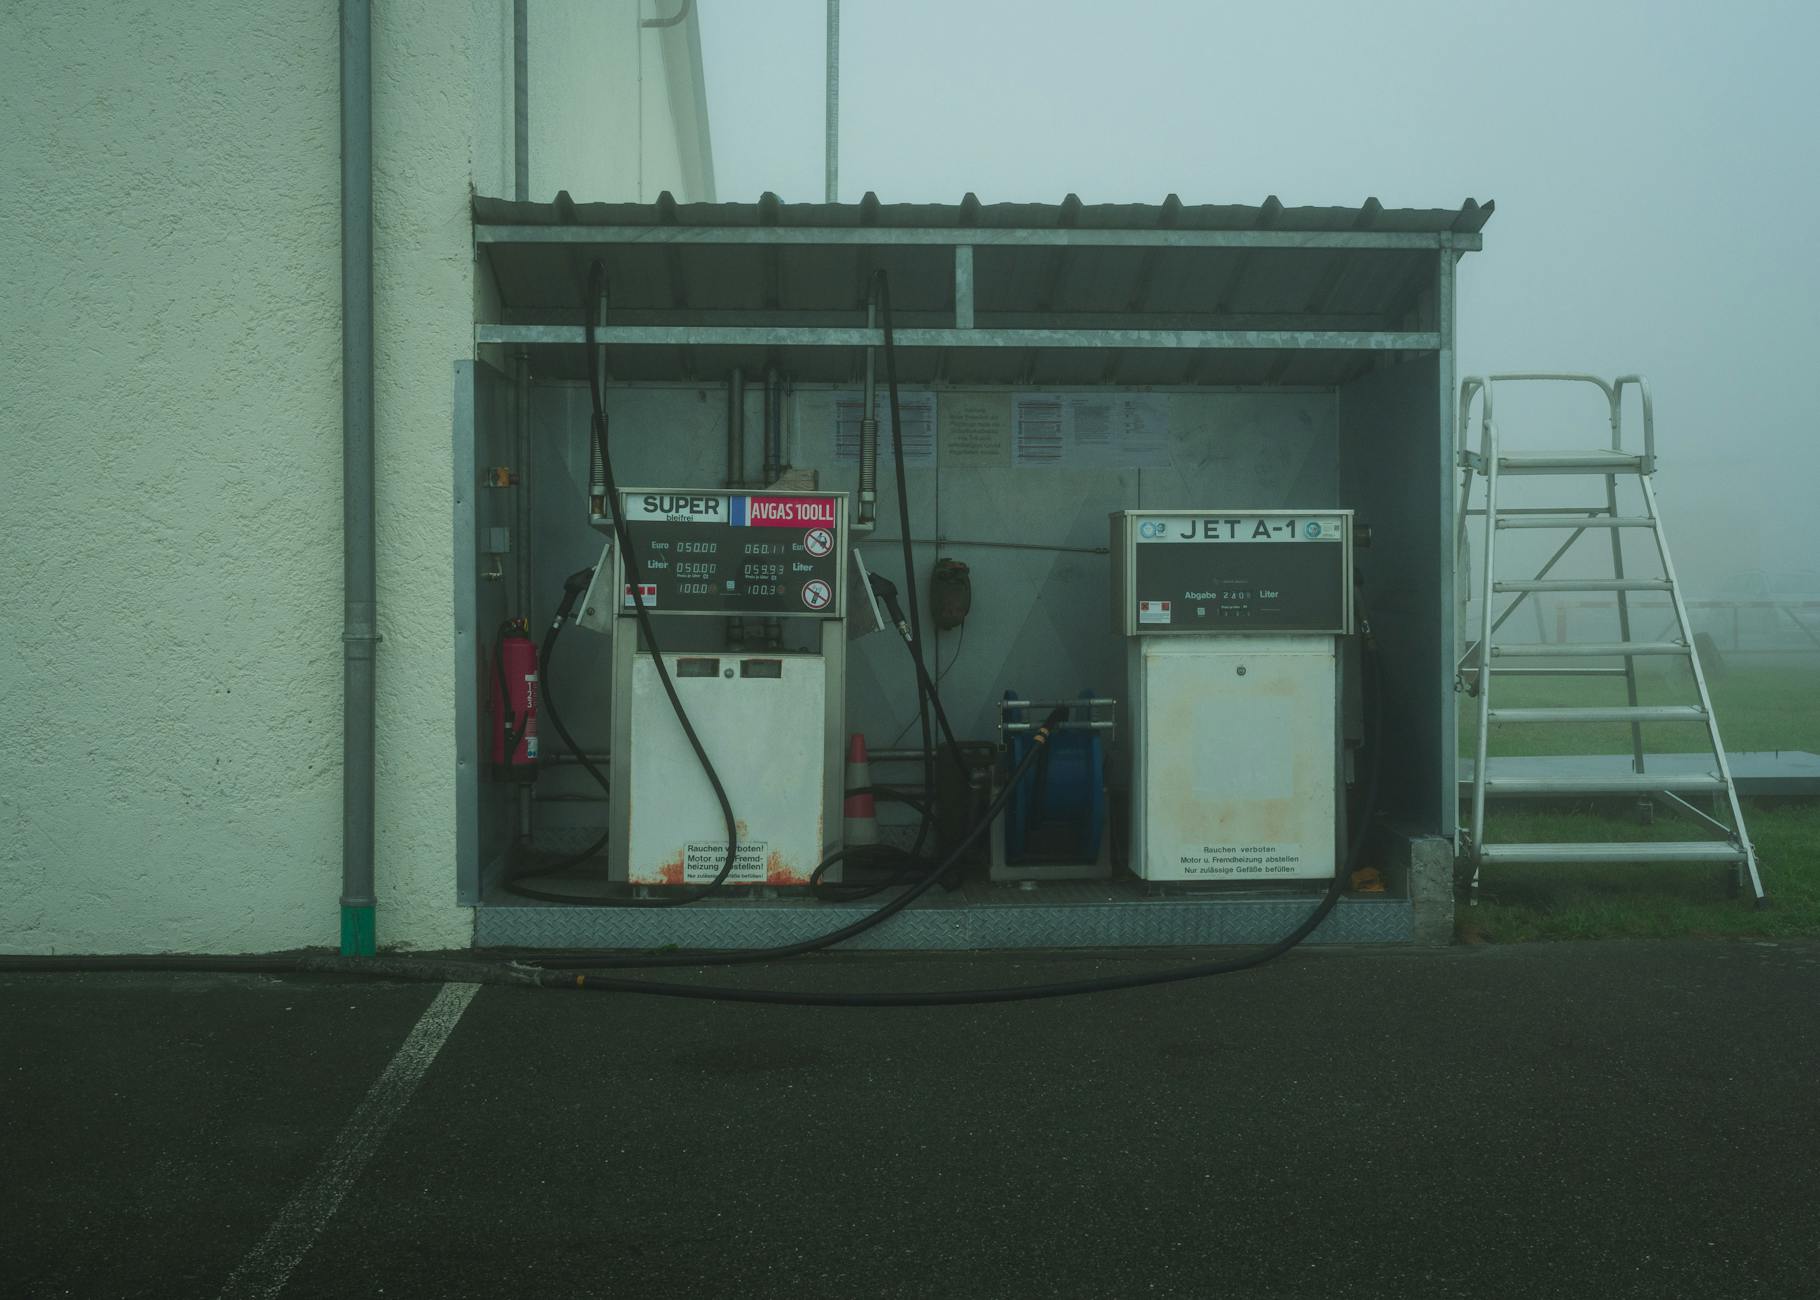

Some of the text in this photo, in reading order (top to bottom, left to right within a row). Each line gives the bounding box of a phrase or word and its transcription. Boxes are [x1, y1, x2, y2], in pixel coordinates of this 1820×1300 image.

[643, 495, 720, 515] SUPER
[751, 502, 834, 521] AVGAS 100LL
[666, 514, 694, 522] bleifrei
[1180, 519, 1241, 539] JET
[1251, 519, 1296, 539] A-1
[651, 541, 670, 550] Euro
[647, 560, 669, 569] Liter
[792, 562, 814, 572] Liter
[1184, 591, 1217, 600] Abgabe
[1259, 589, 1279, 599] Liter
[1212, 856, 1263, 864] Fremdheizung
[687, 863, 719, 872] heizung
[1199, 866, 1234, 875] zulässige
